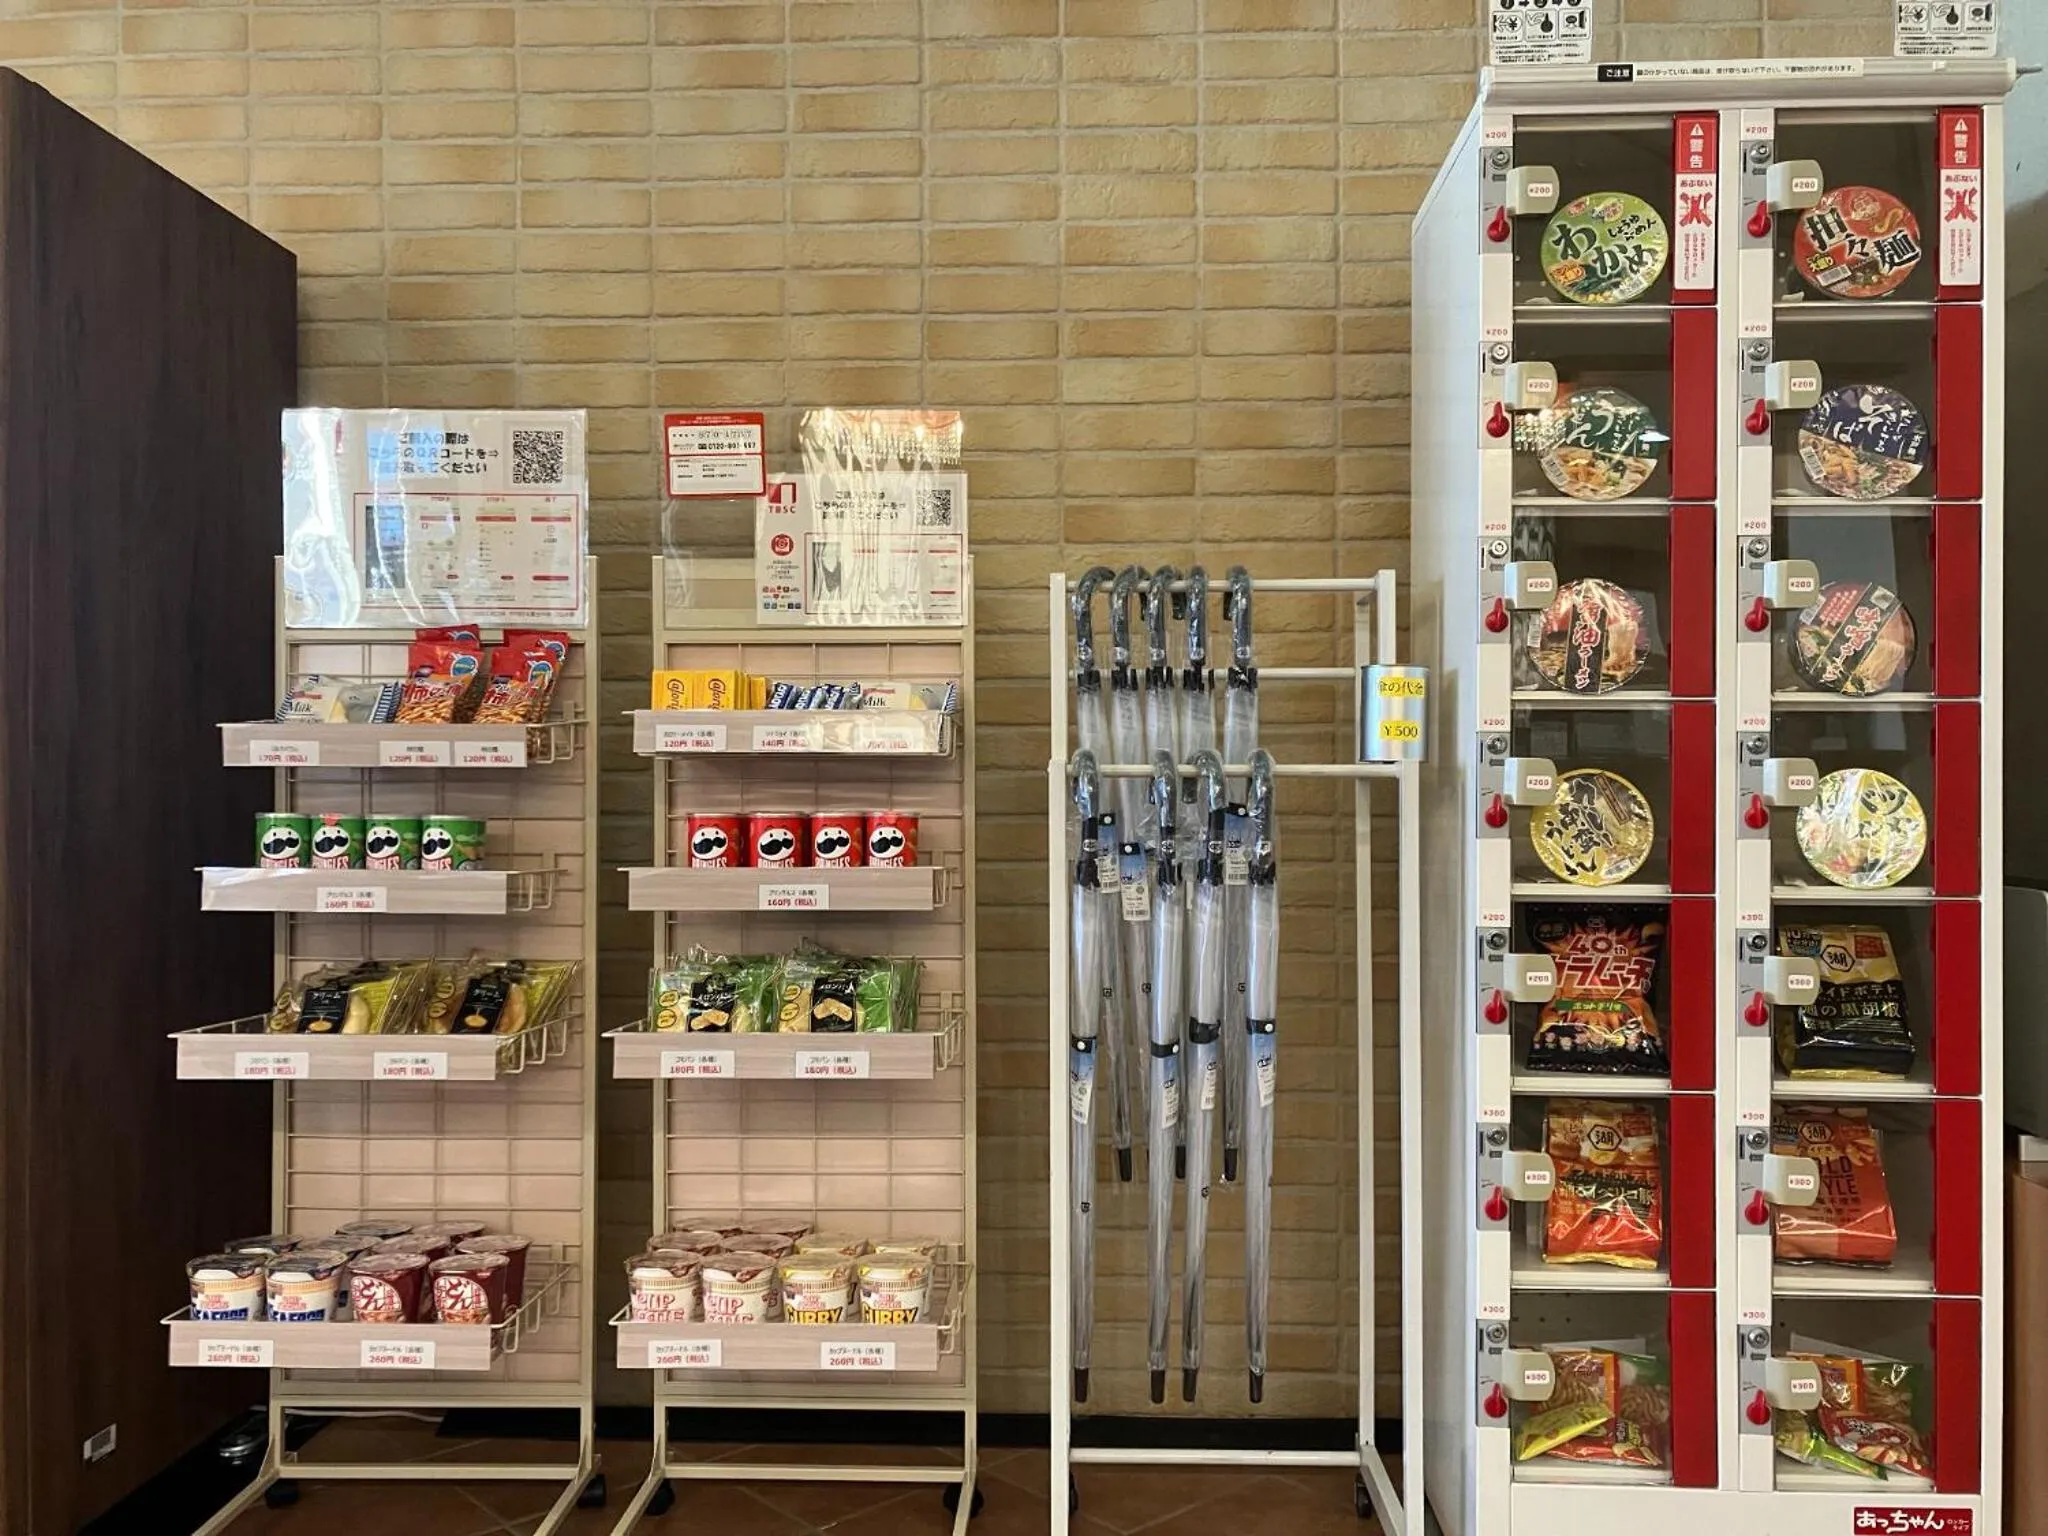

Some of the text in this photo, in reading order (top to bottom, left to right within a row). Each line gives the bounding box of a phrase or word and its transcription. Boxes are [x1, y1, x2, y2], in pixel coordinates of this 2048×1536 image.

[1551, 223, 1659, 278] わかめ
[1856, 1509, 1945, 1534] あっちゃん
